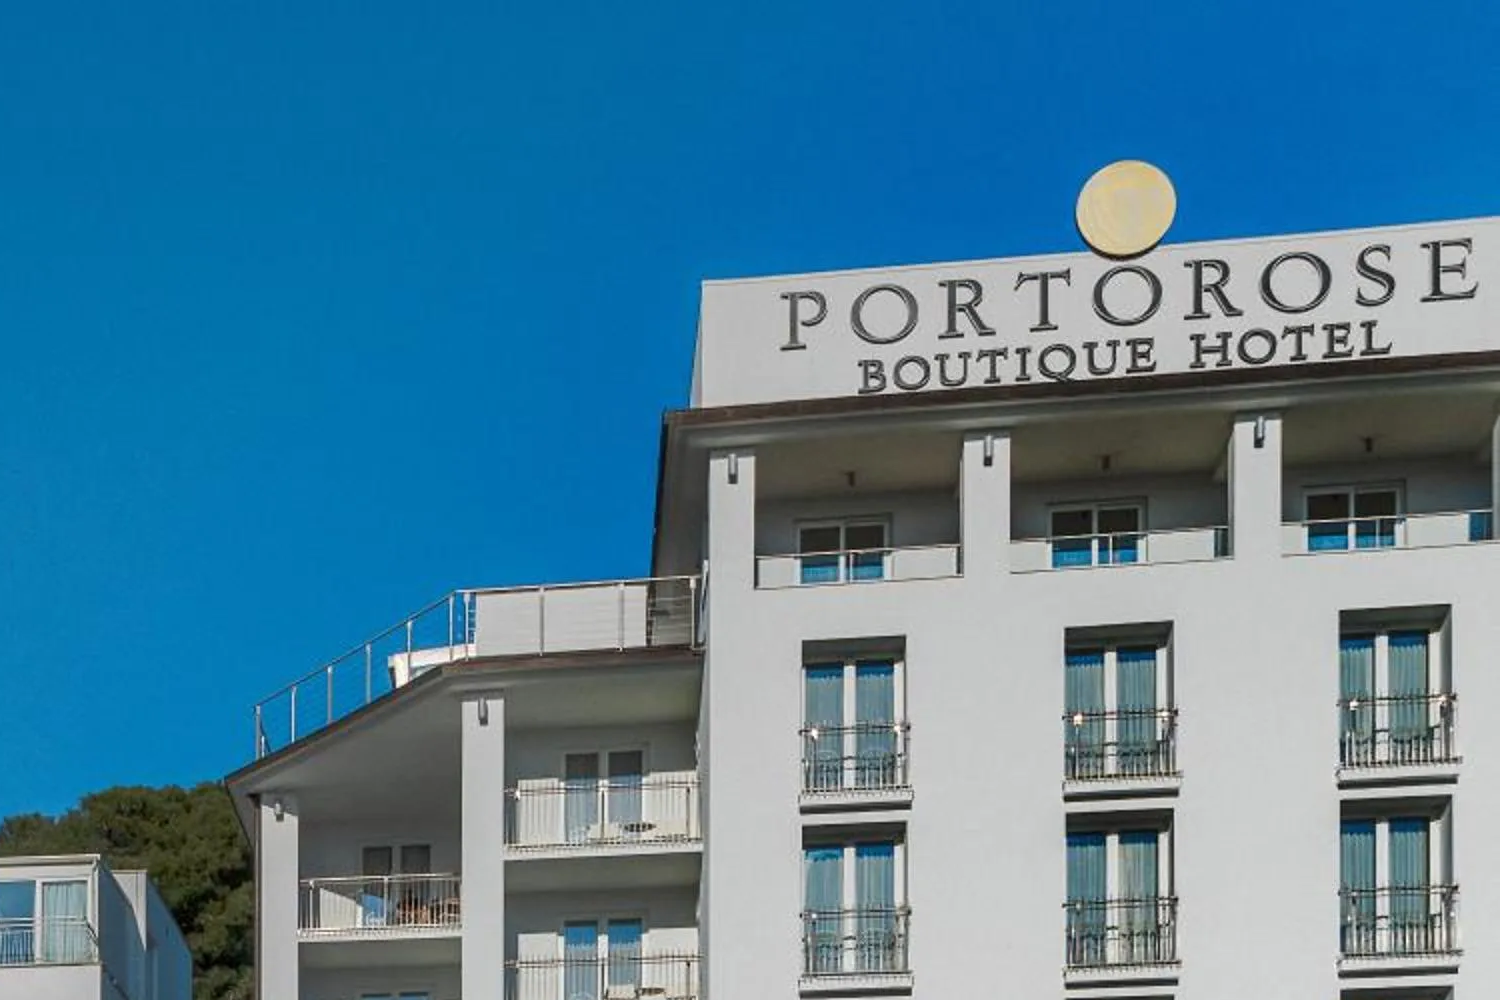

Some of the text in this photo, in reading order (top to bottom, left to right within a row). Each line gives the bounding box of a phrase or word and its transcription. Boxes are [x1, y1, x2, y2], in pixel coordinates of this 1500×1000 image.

[779, 237, 1479, 351] PORTOROSE
[857, 319, 1393, 395] BOUTIQUE HOTEL
